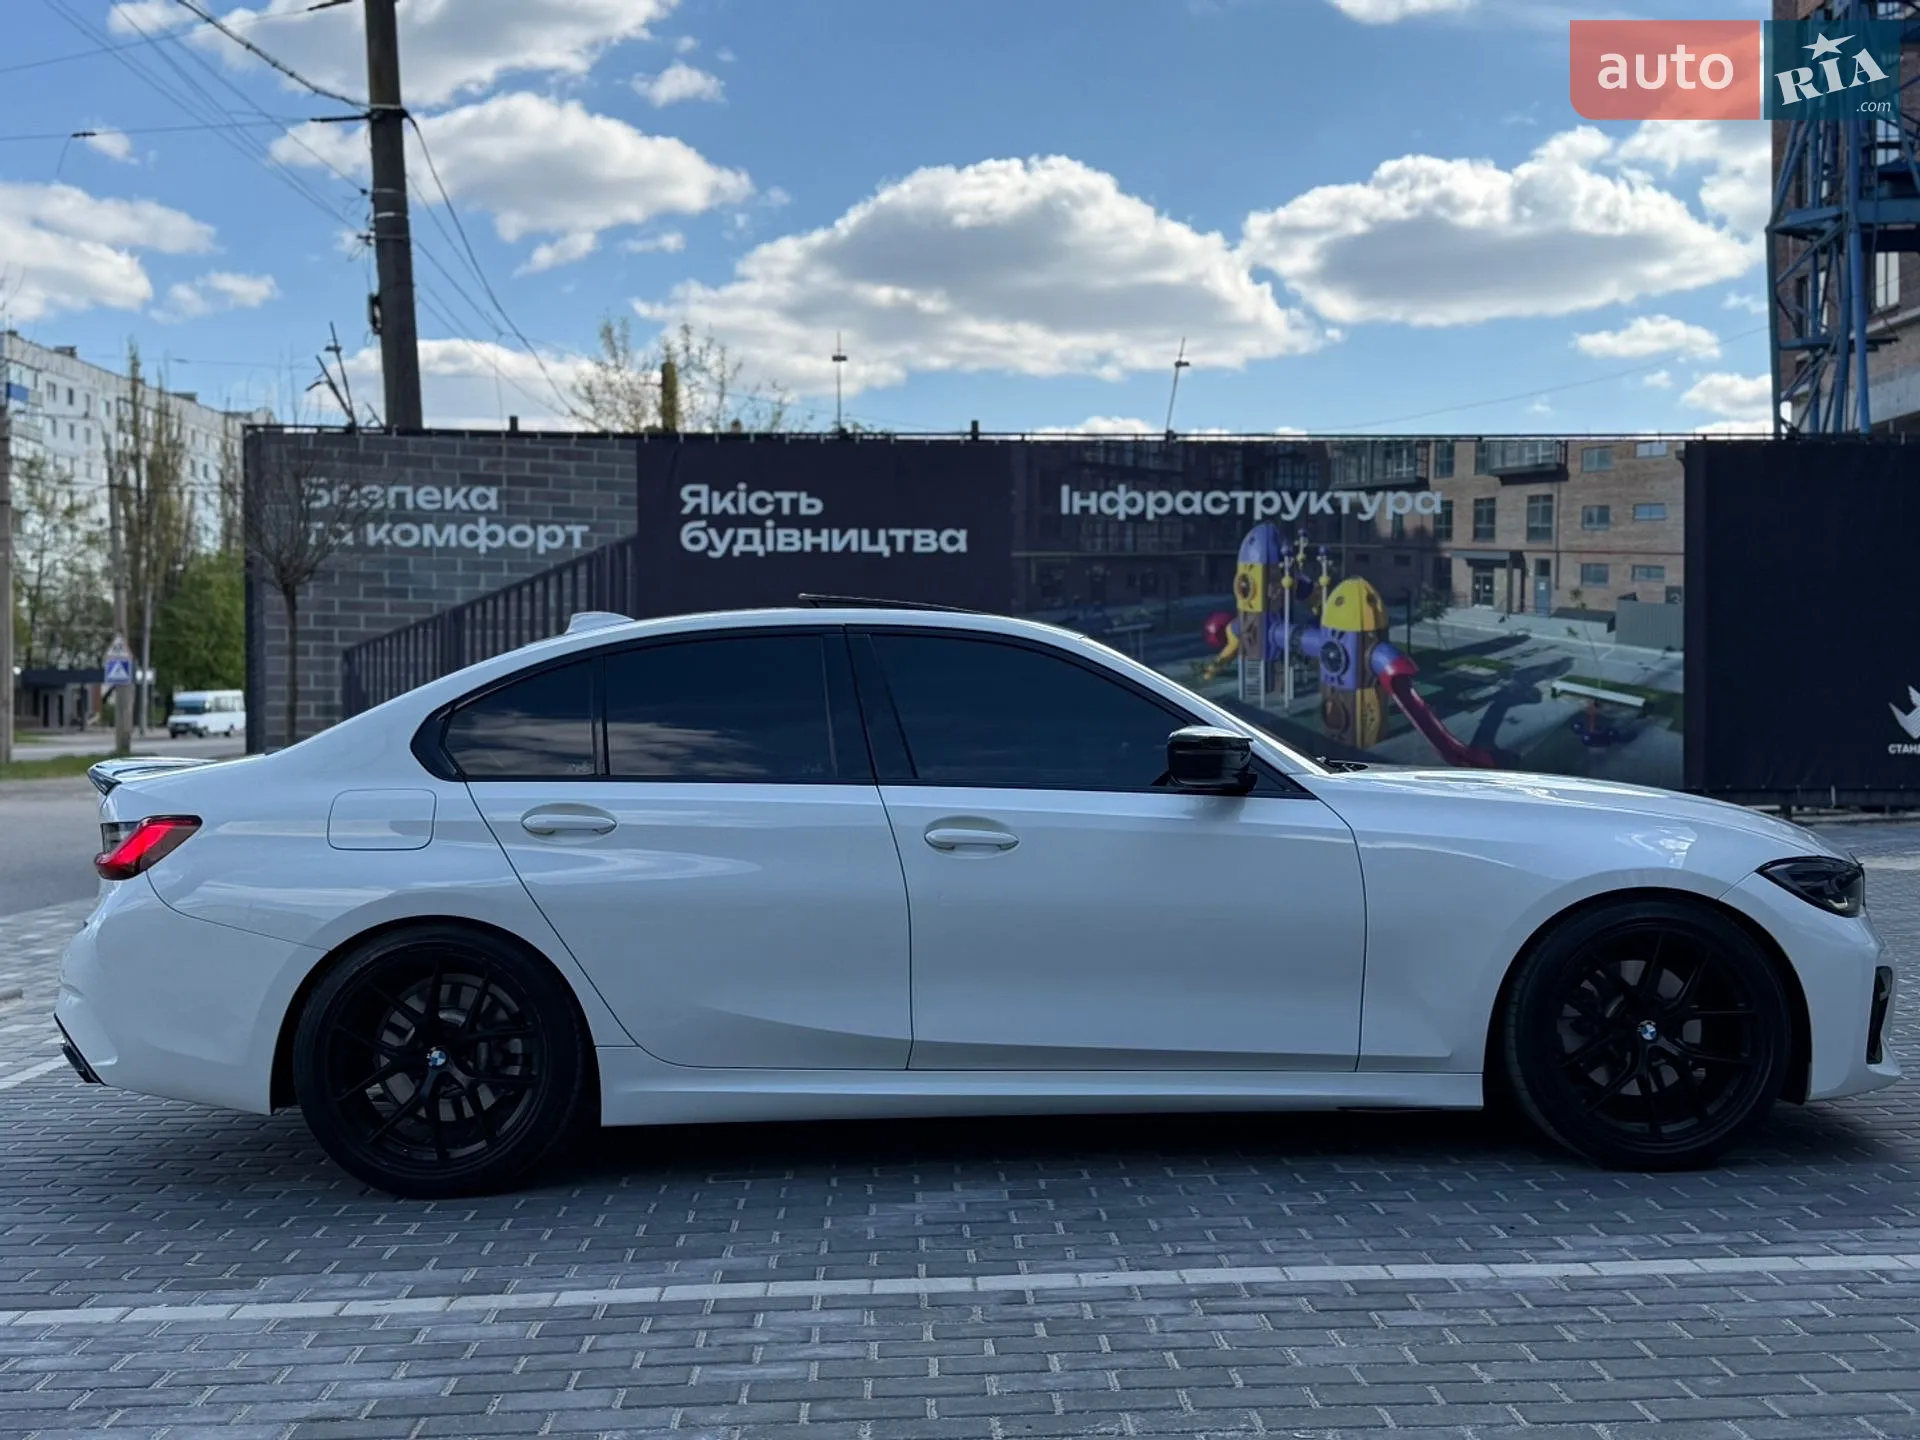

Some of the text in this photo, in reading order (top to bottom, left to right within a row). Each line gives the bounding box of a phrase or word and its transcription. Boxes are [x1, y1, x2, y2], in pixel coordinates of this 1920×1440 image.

[680, 482, 824, 516] Якість
[1060, 484, 1443, 521] Інфраструктура
[366, 516, 590, 554] комфорт
[680, 520, 968, 559] будівництва
